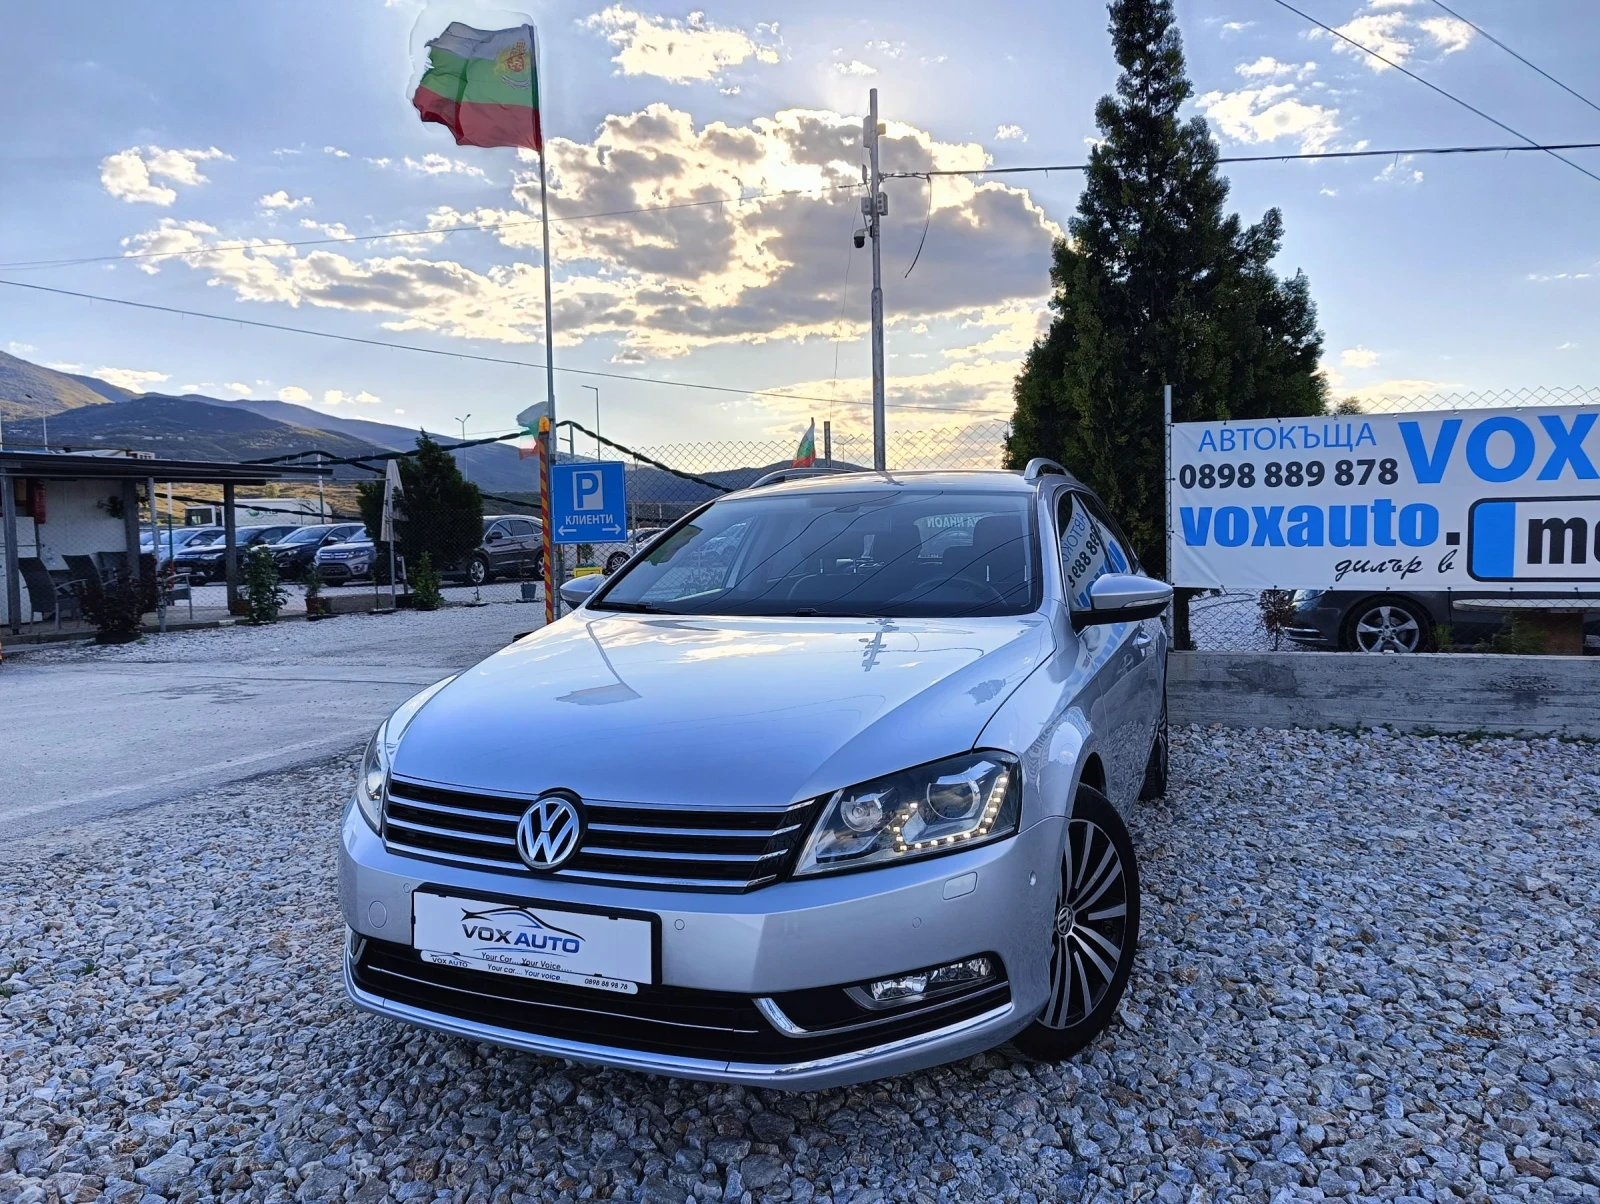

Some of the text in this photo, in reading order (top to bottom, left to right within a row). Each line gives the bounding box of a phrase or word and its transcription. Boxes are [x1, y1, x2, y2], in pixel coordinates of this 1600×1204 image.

[1198, 422, 1377, 452] АВТОКЪЩА
[1398, 413, 1600, 483] VOX
[1179, 458, 1399, 489] 0898 889 878
[565, 514, 614, 525] КЛИЕНТИ
[1527, 517, 1600, 564] m
[1335, 556, 1423, 582] дилър
[462, 924, 580, 953] VOX AUTO
[448, 959, 468, 967] AUTO
[481, 952, 498, 961] Your
[521, 957, 538, 968] Your
[487, 963, 503, 972] Your
[524, 969, 540, 978] Your
